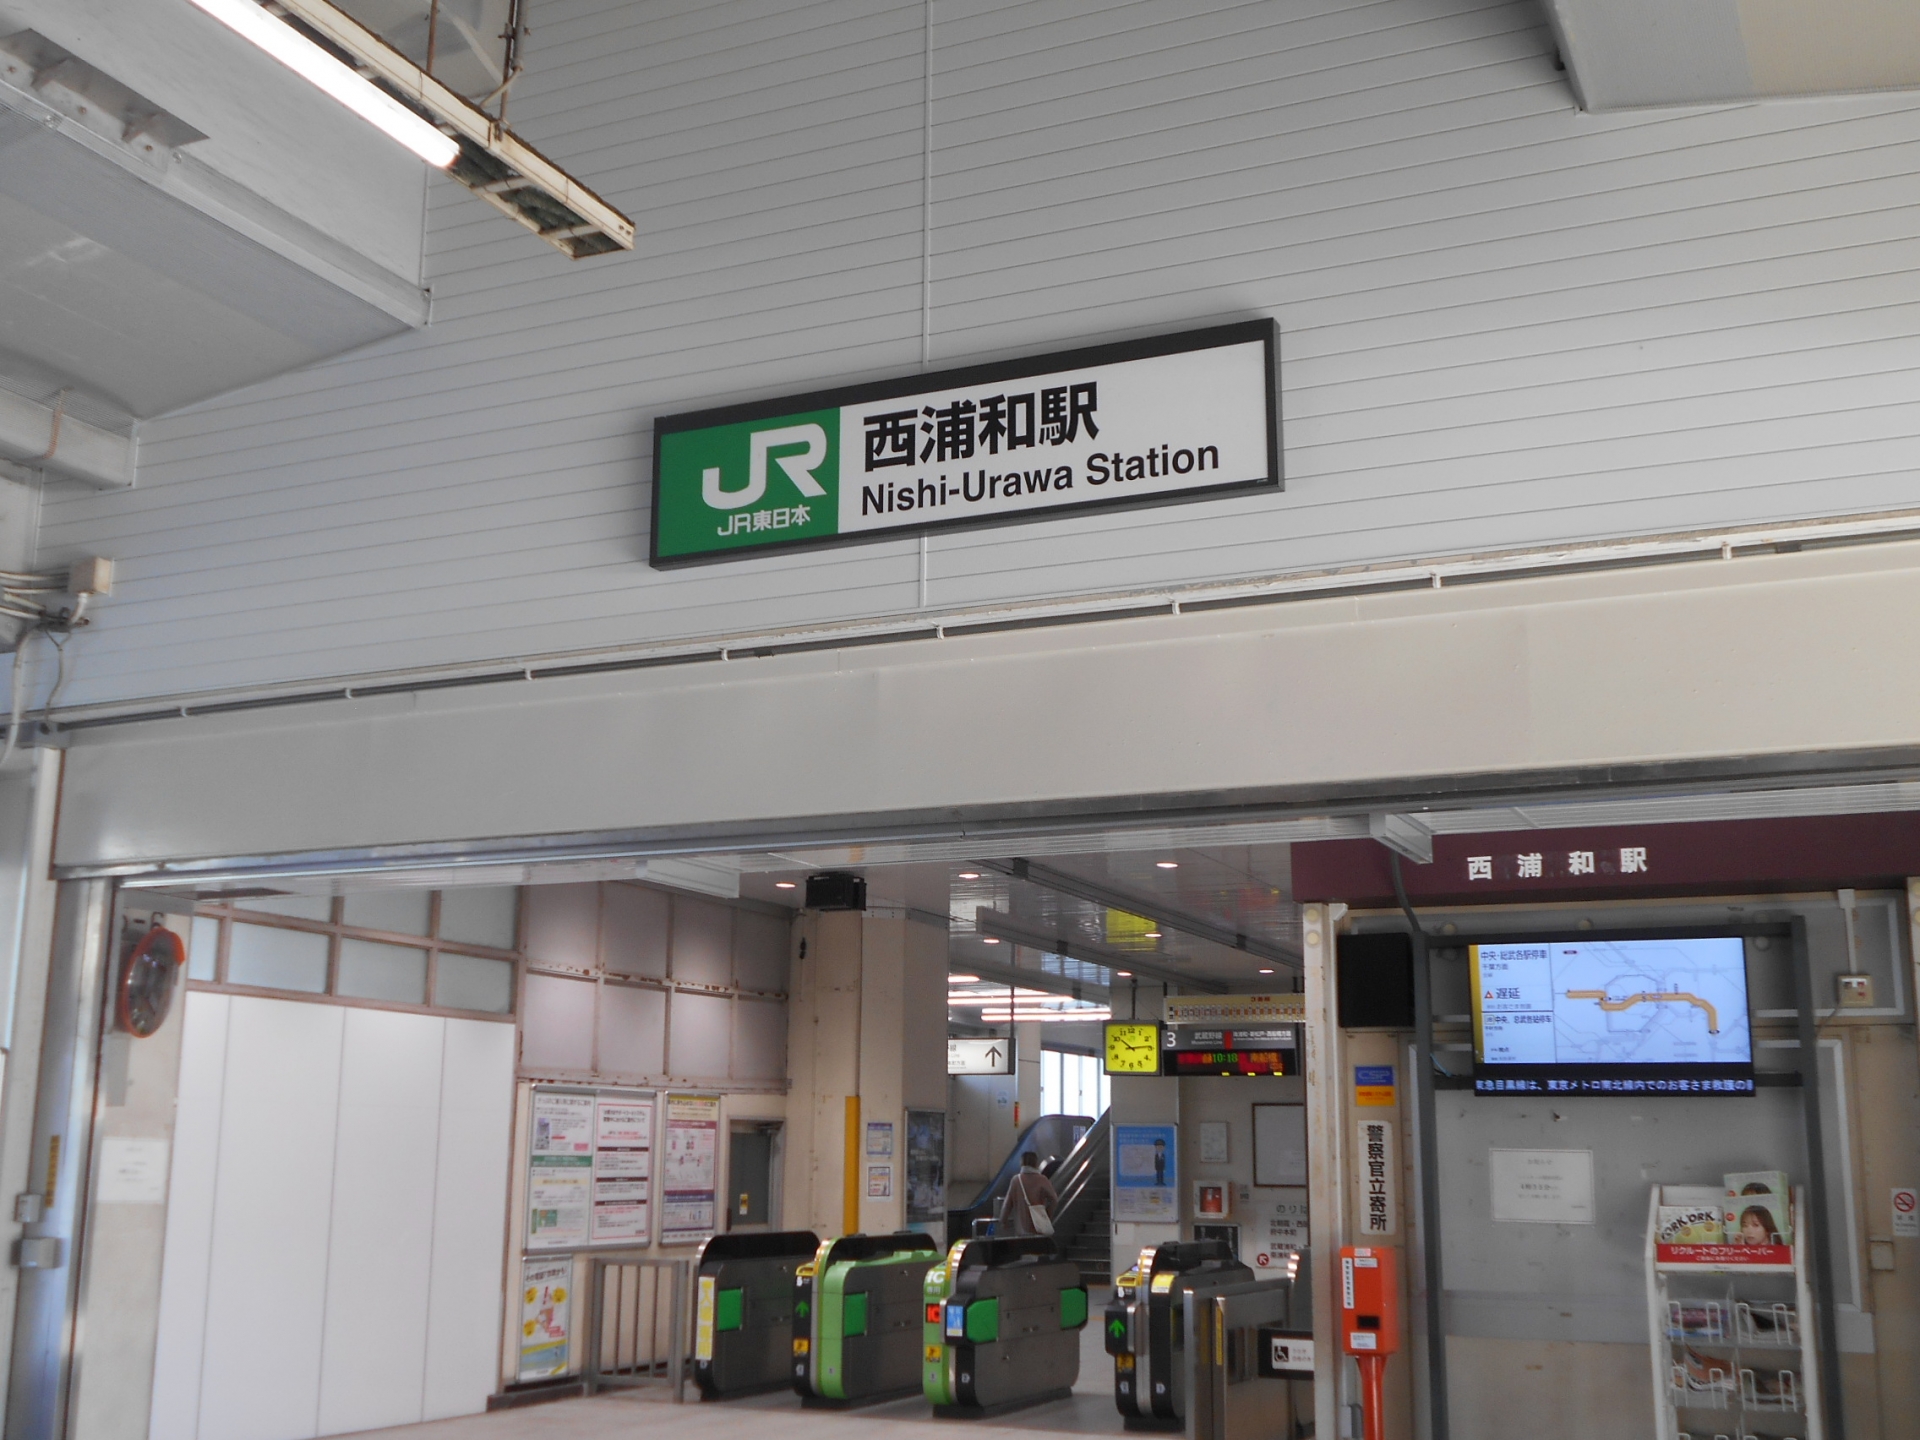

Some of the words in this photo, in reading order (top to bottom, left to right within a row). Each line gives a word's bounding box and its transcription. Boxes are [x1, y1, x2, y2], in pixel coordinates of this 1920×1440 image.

[863, 381, 1100, 472] 西浦和駅
[702, 423, 827, 510] JR
[862, 465, 1074, 516] Nishi-Urawa
[1086, 444, 1219, 486] Station
[717, 504, 811, 536] JR東日本
[1467, 847, 1648, 881] 西浦和駅
[1166, 1031, 1176, 1047] 3
[1367, 1125, 1387, 1231] 警察官立寄所
[926, 1270, 946, 1284] IC
